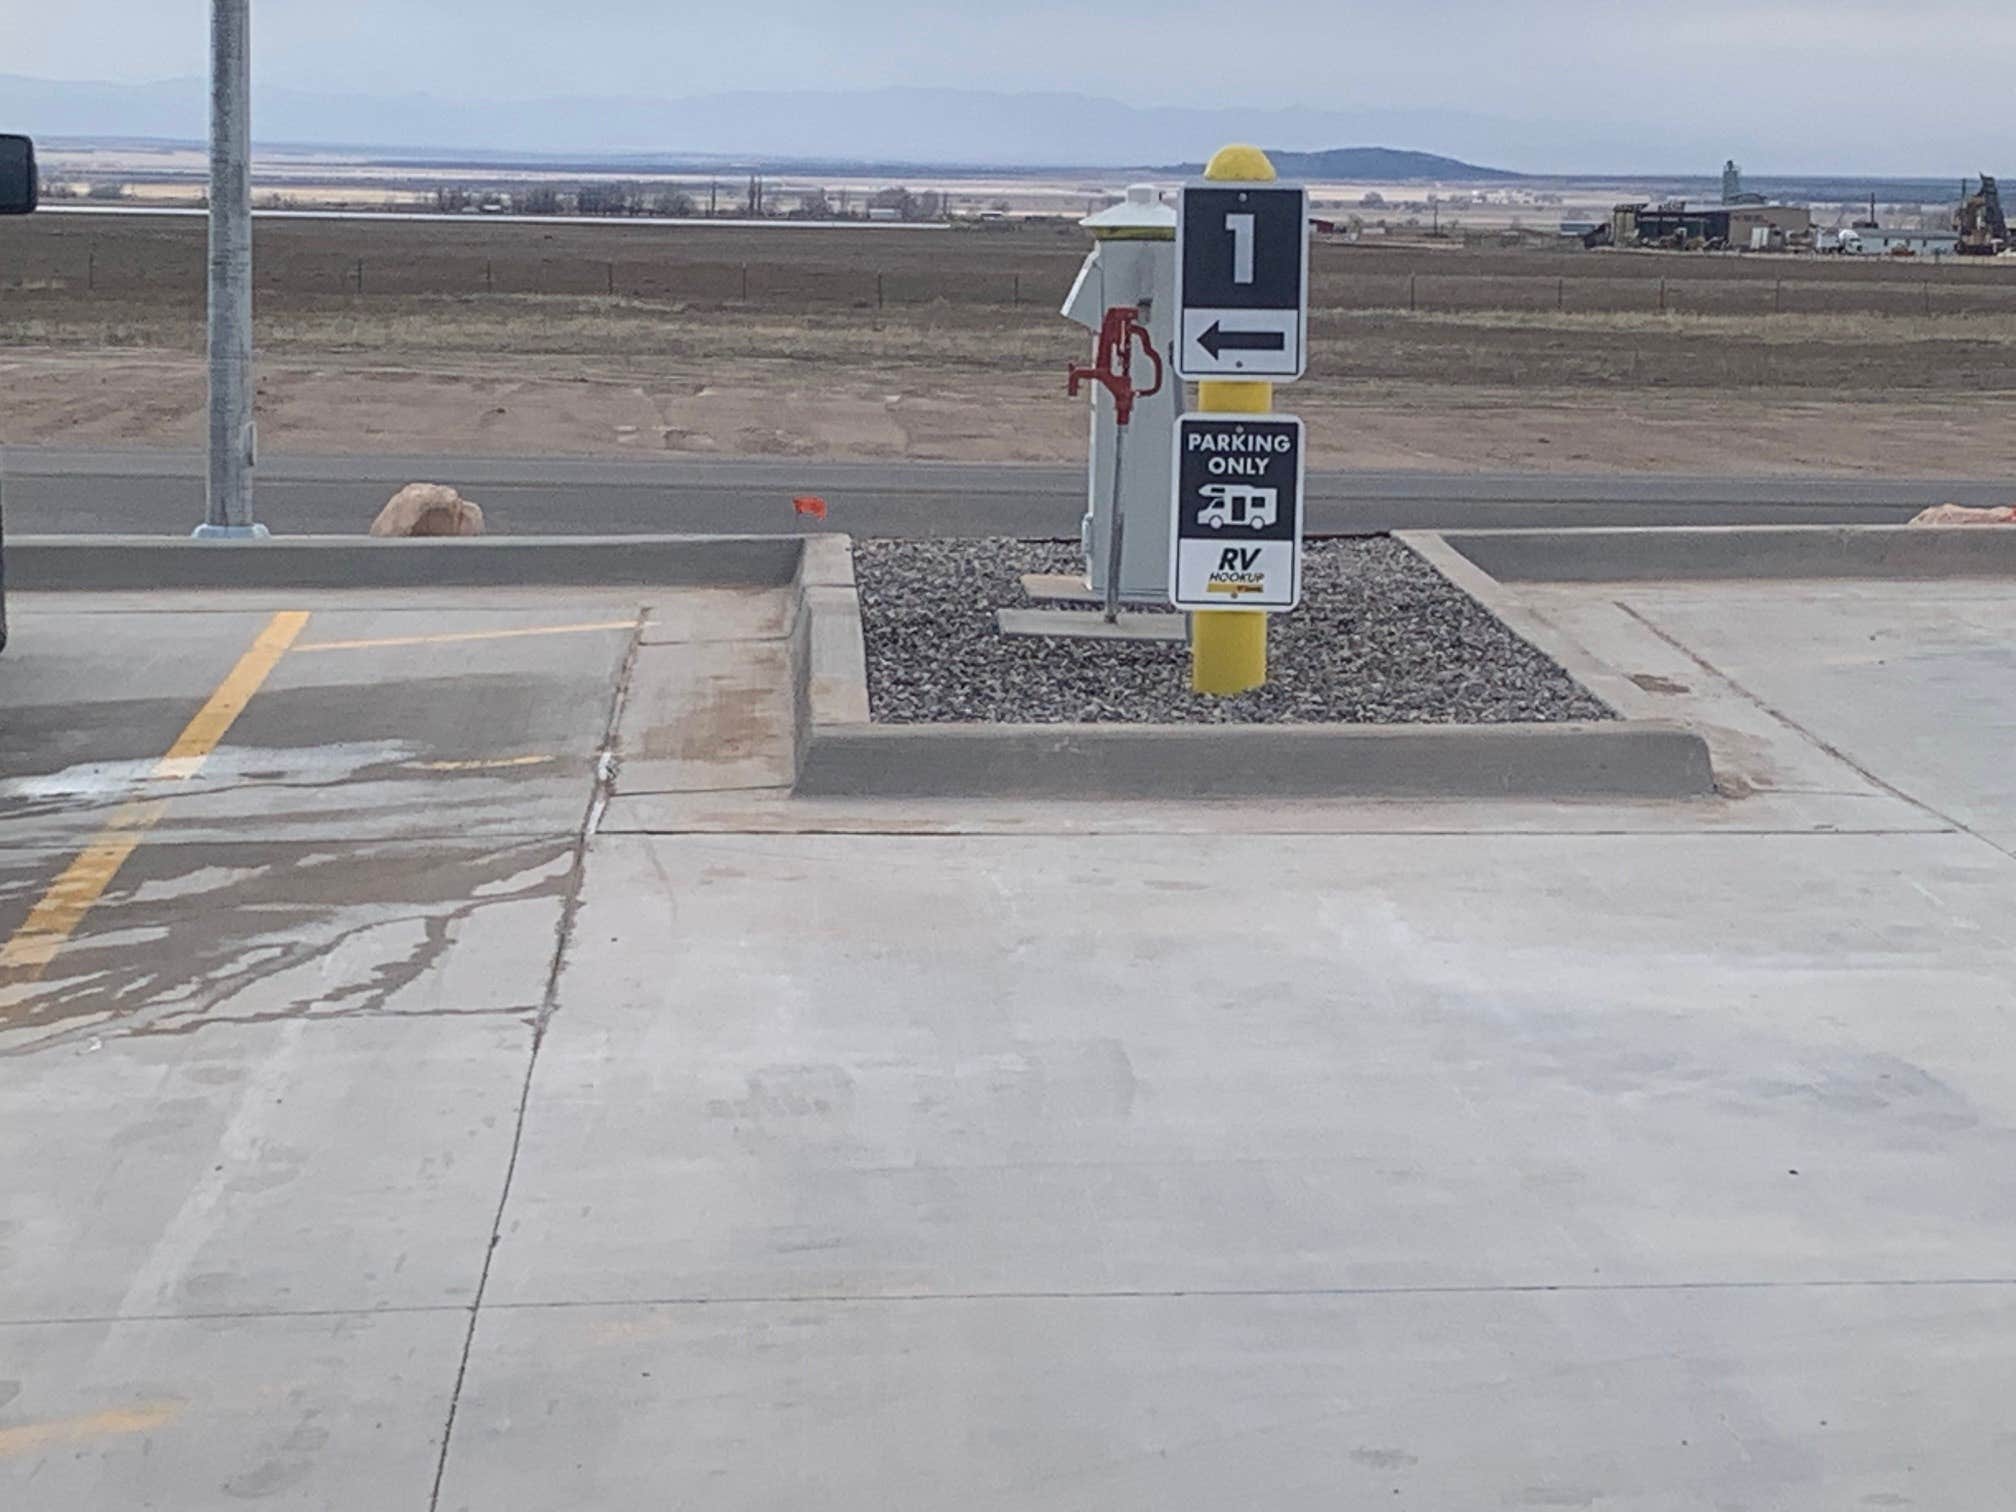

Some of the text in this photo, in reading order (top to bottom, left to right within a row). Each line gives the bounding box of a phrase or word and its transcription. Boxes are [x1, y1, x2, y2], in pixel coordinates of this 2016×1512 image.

[1225, 213, 1255, 284] 1
[1187, 433, 1291, 453] PARKING
[1208, 456, 1270, 475] ONLY
[1218, 547, 1262, 571] RV
[1209, 572, 1265, 583] HOOKUP
